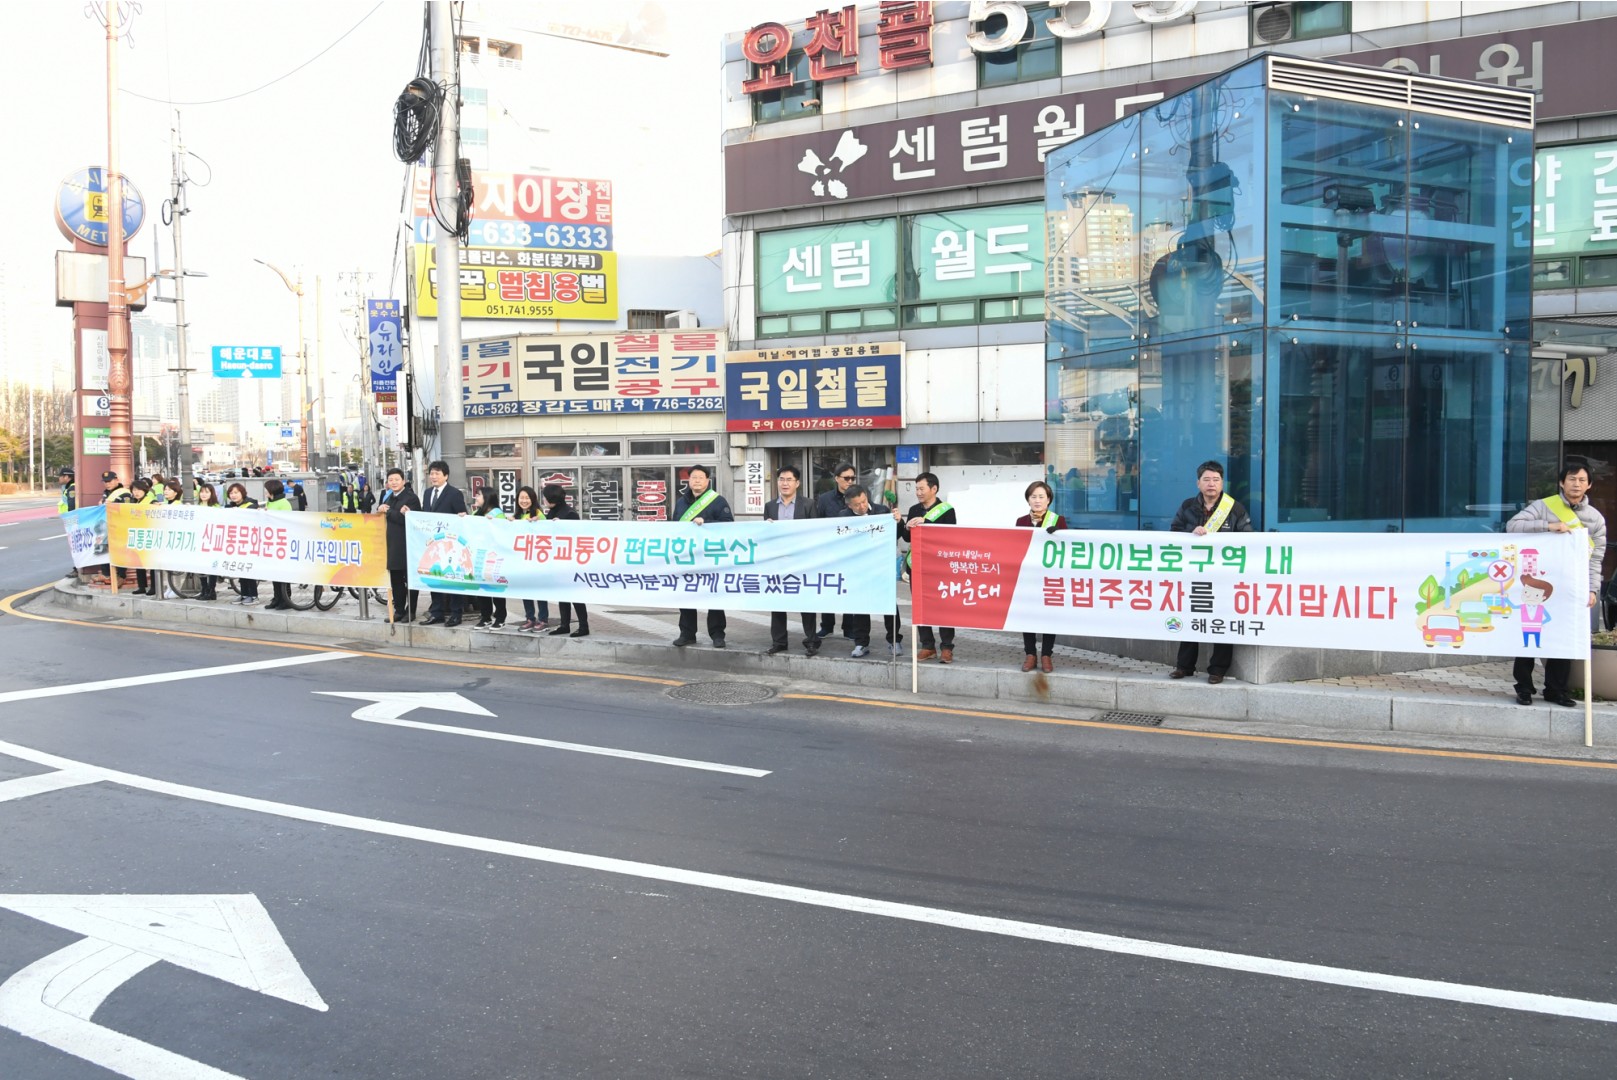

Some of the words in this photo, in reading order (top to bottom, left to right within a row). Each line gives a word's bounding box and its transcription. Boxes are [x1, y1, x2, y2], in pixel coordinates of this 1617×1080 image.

[595, 181, 611, 223] 전문
[419, 219, 608, 249] 0-633-6333
[782, 239, 871, 293] 센텀
[931, 224, 1032, 281] 월드
[486, 305, 554, 316] 051.741.9555
[219, 347, 274, 361] 해운대로
[377, 323, 395, 375] 뉴라인
[613, 333, 720, 354] 철물
[523, 341, 610, 392] 국일
[614, 355, 717, 375] 전기
[614, 378, 720, 396] 공구
[740, 365, 888, 411] 국일철물
[464, 402, 518, 416] 746-5262
[521, 399, 612, 414] 장갑도매
[653, 397, 723, 410] 746-5262
[781, 418, 873, 429] (051)746-5262
[127, 528, 164, 550] 교통질서
[304, 540, 362, 566] 시작입니다
[513, 534, 619, 565] 대중교통이
[623, 536, 697, 566] 편리한
[703, 537, 758, 566] 부산
[1042, 539, 1247, 574] 어린이보호구역
[1264, 545, 1293, 575] 내
[949, 560, 979, 575] 행복한
[980, 562, 1001, 575] 도시
[573, 572, 680, 592] 시민여러분과
[681, 572, 720, 594] 함께
[723, 572, 848, 595] 만들겠습니다.
[937, 578, 1001, 606] 해운대
[1042, 576, 1215, 614] 불법주정차를
[1233, 581, 1398, 620] 하지맙시다
[1190, 617, 1266, 636] 해운대구
